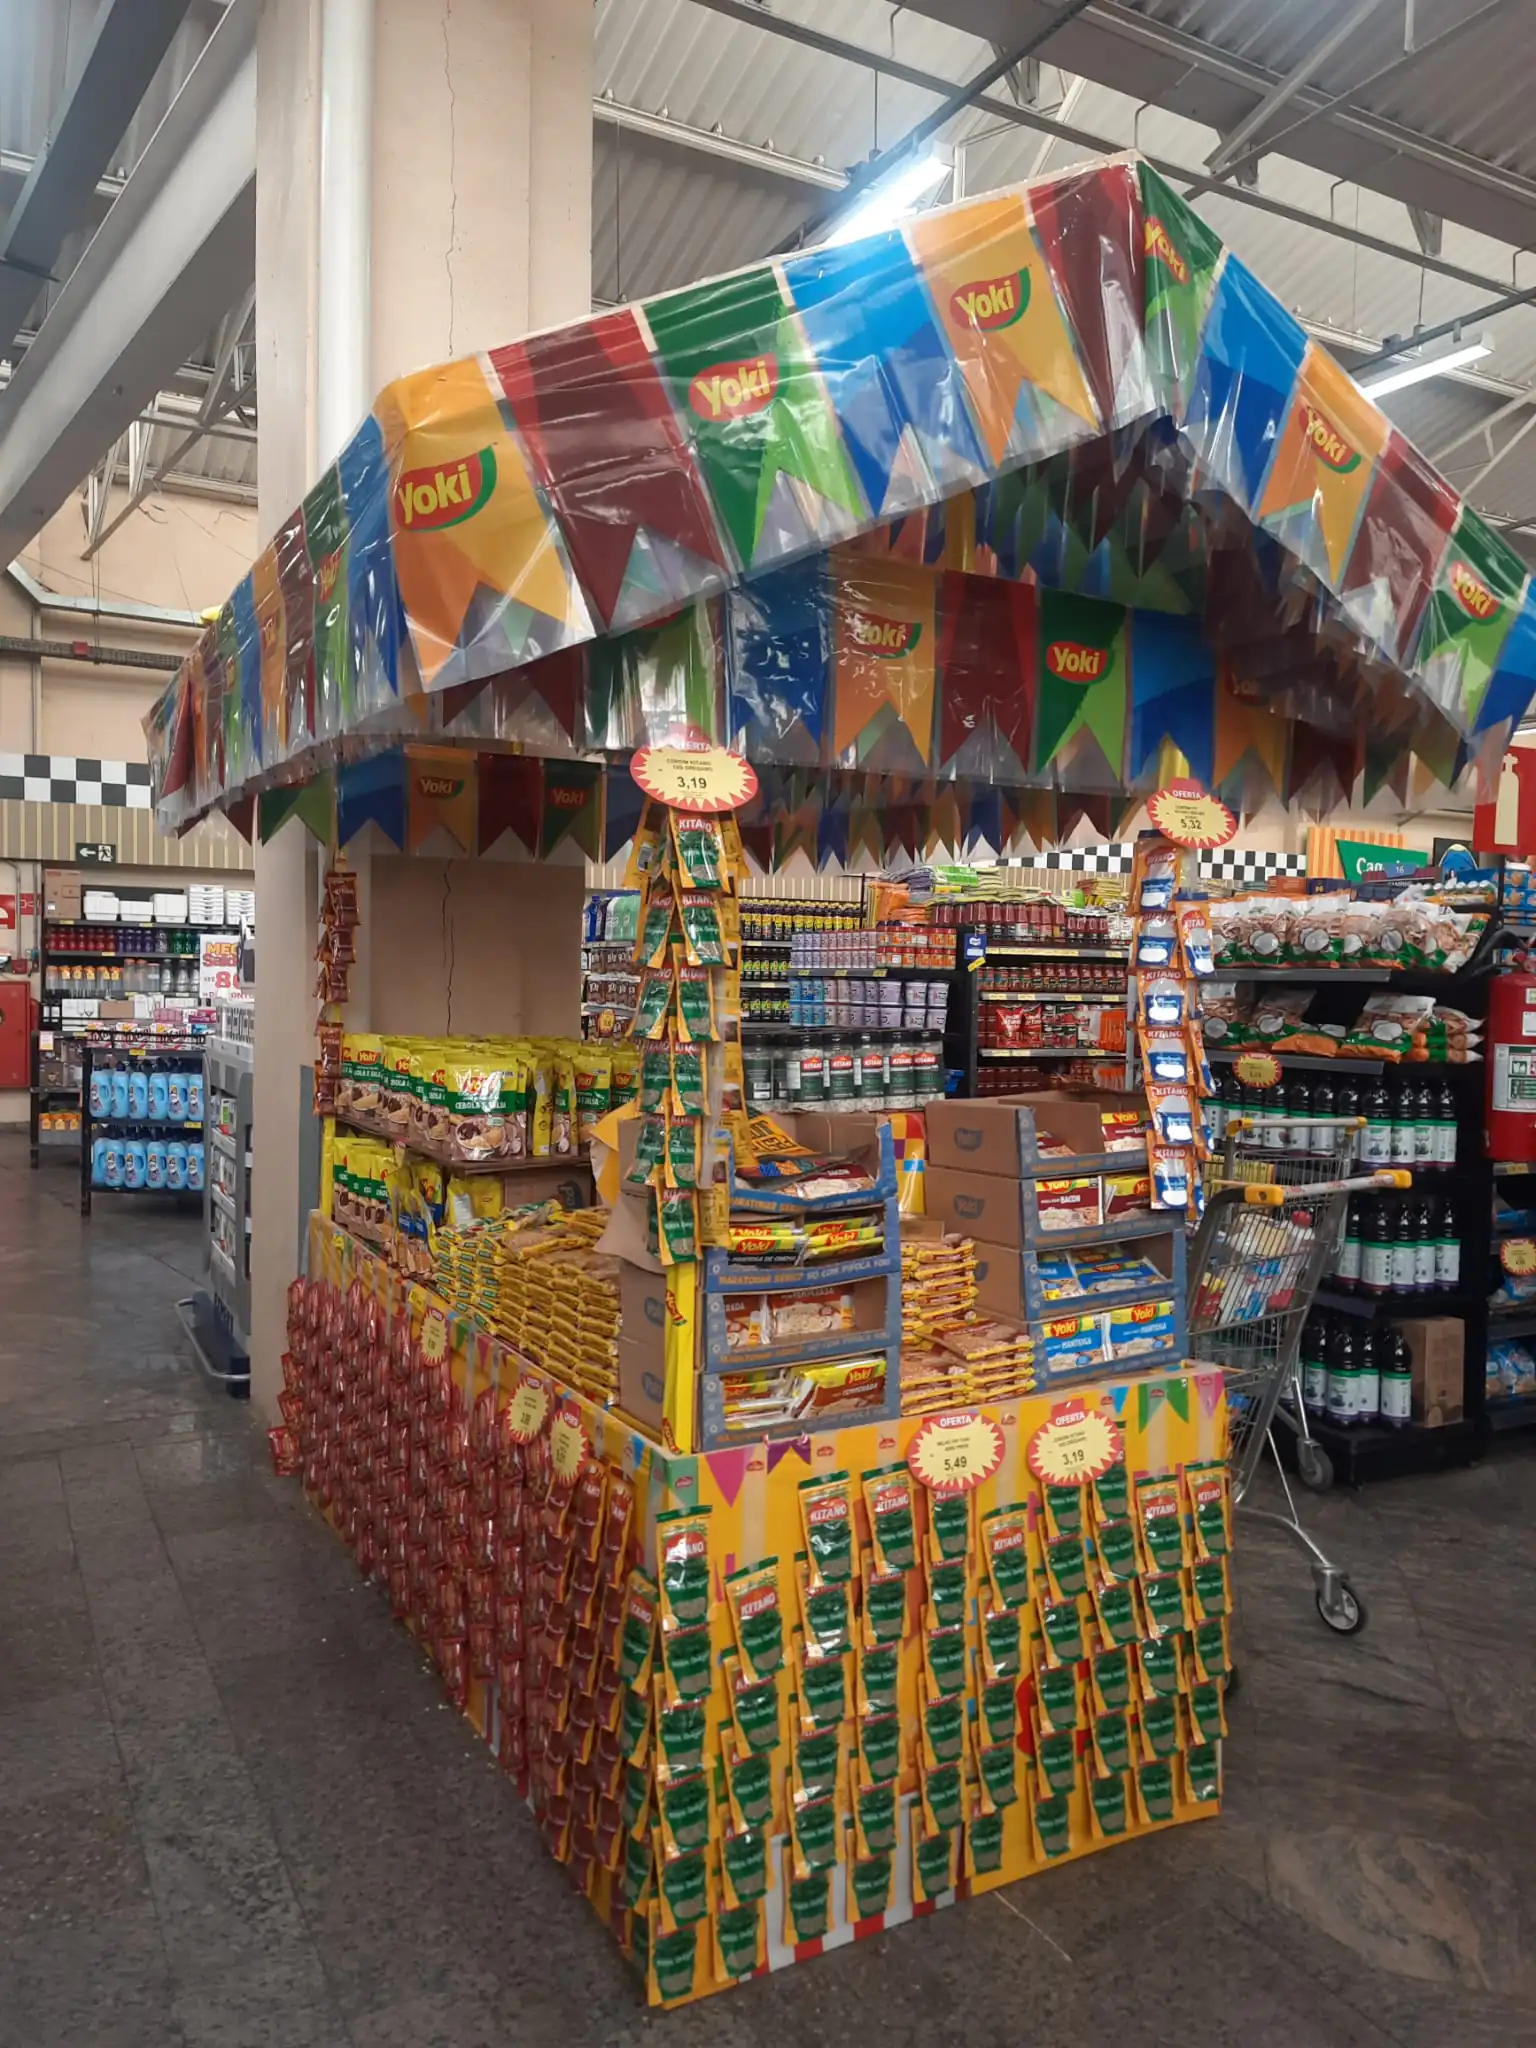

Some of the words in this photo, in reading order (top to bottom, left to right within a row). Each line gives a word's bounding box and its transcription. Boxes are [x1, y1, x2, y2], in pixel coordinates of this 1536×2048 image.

[1145, 221, 1185, 282] Yoki
[955, 280, 1014, 325] Yoki
[695, 360, 770, 416] Yoki
[1307, 408, 1346, 463] Yoki
[398, 464, 472, 524] Yoki
[1455, 563, 1492, 615] Yoki
[1054, 646, 1099, 675] Yoki
[420, 778, 453, 795] Yoki
[676, 776, 707, 789] 3,19
[553, 789, 584, 805] Yoki
[1172, 789, 1200, 799] OFERTA
[1180, 818, 1202, 830] 5,32
[1146, 970, 1181, 980] KITANO
[1147, 1029, 1183, 1038] KITANO
[1116, 1113, 1139, 1122] Yoki
[1060, 1195, 1081, 1204] BACON
[829, 1232, 857, 1243] Yoki
[740, 1240, 770, 1252] Yoki
[1134, 1305, 1155, 1320] Yoki
[1053, 1322, 1076, 1336] Yoki
[1061, 1337, 1093, 1349] MANTEIGA
[850, 1370, 872, 1383] Yoki
[940, 1415, 972, 1427] OFERTA
[1056, 1411, 1085, 1426] OFERTA
[944, 1456, 967, 1472] 5,49
[1062, 1449, 1085, 1466] 3,19
[876, 1493, 909, 1511] KITANO
[809, 1503, 848, 1523] KITANO
[1146, 1503, 1177, 1518] KITANO
[993, 1532, 1023, 1550] KITANO
[741, 1592, 776, 1616] KITANO
